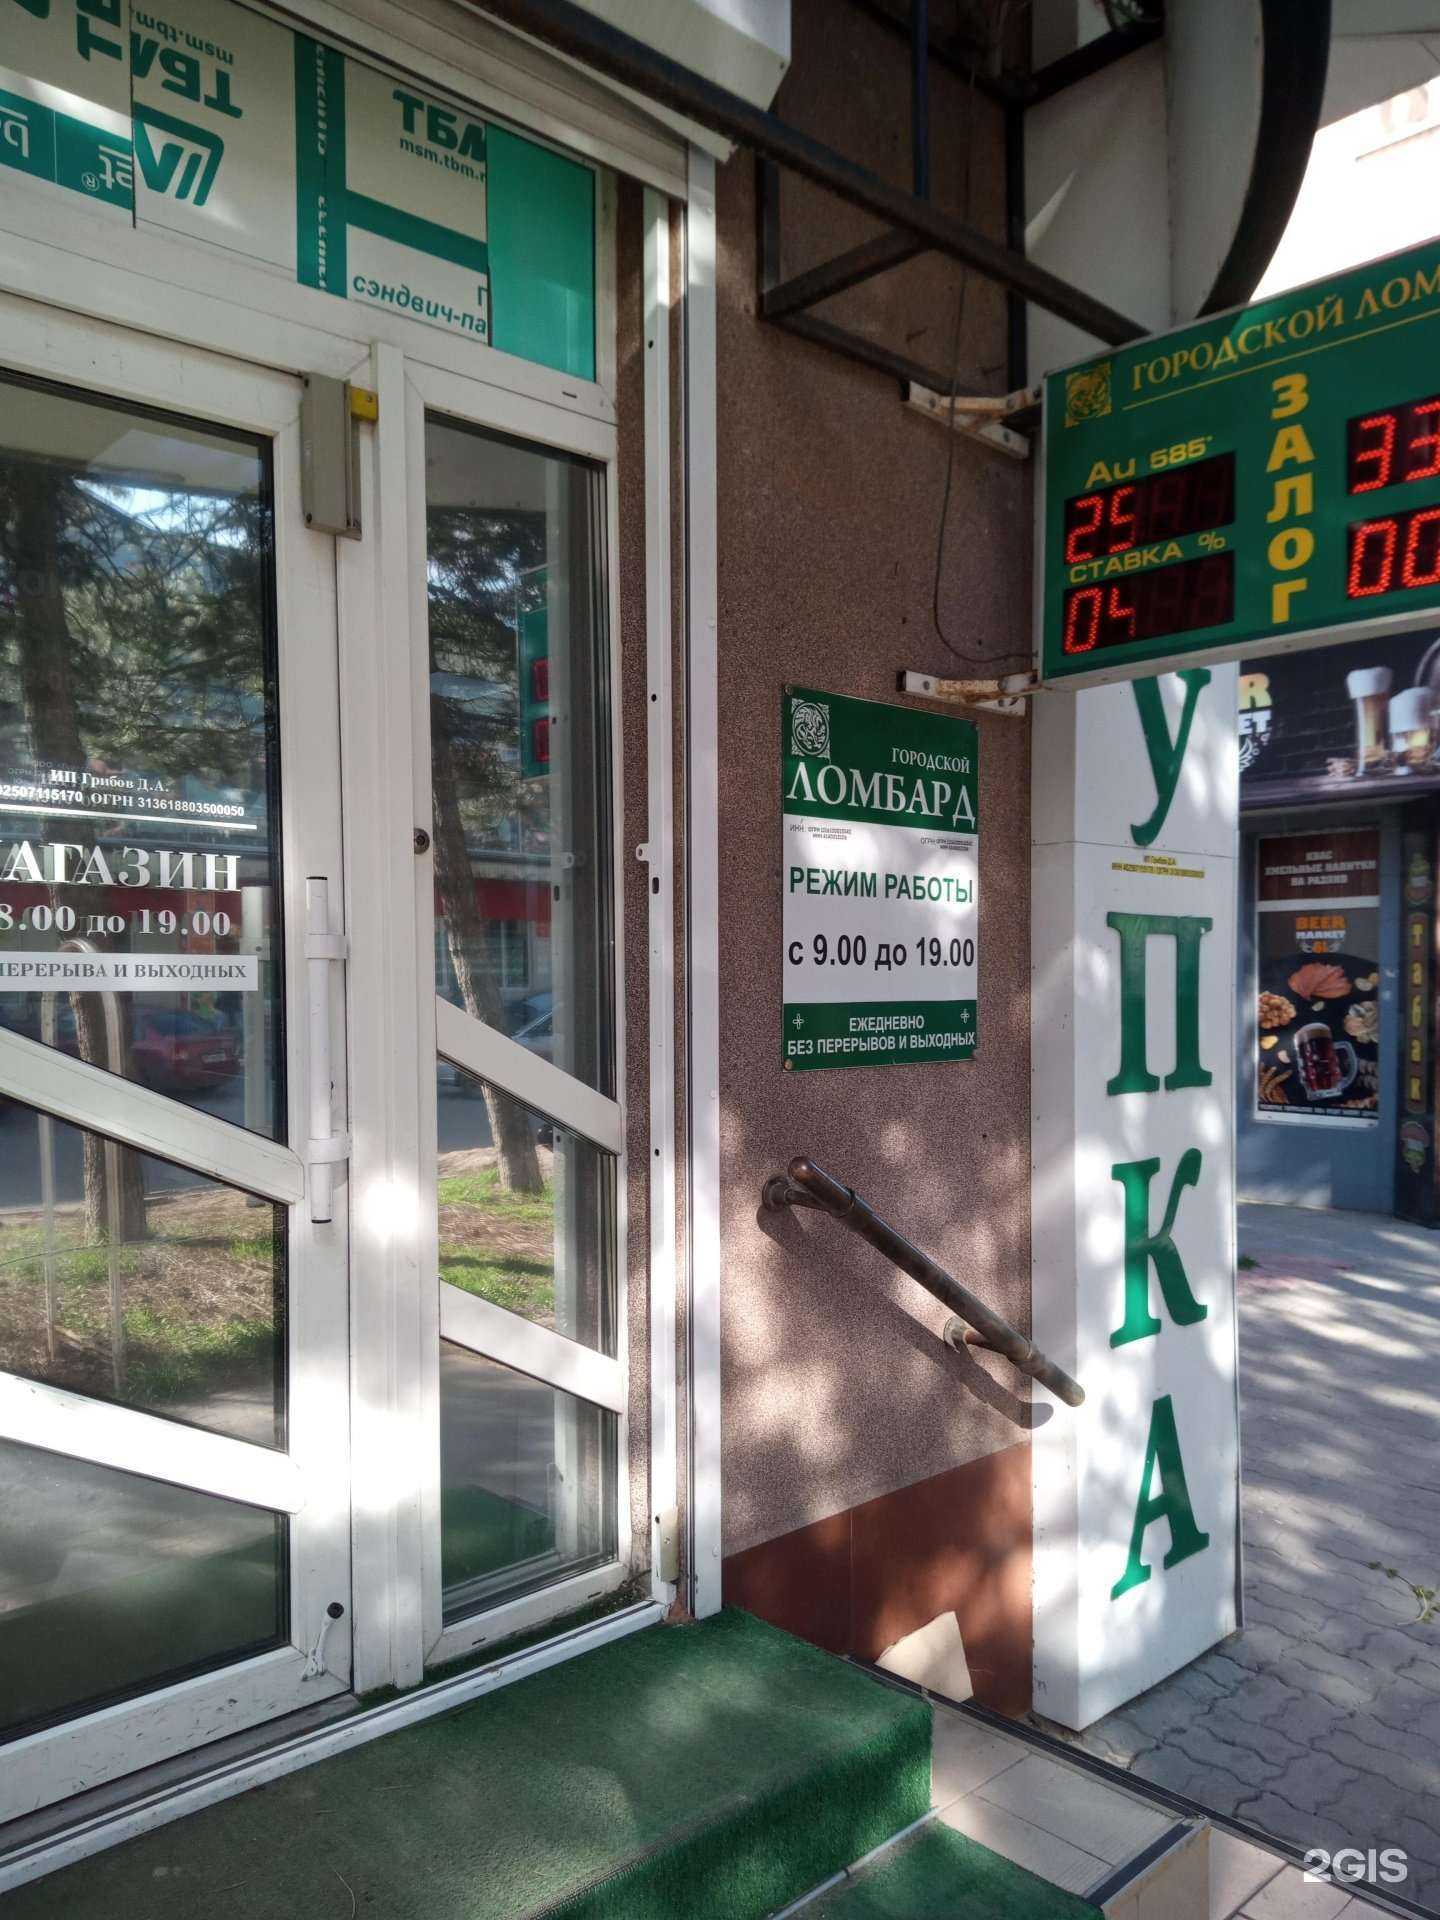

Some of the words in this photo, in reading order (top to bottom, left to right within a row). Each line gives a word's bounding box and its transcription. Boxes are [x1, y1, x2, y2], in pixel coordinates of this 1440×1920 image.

[1131, 294, 1344, 391] ГОРОДСКОЙ
[1085, 457, 1137, 489] Au
[1266, 372, 1315, 625] ЗАЛОГ
[1065, 486, 1136, 564] 25
[1069, 542, 1185, 584] СТАВКА
[1063, 586, 1136, 655] 04
[50, 769, 77, 784] ИП
[82, 772, 134, 789] Грибов
[892, 747, 970, 774] ГОРОДСКОЙ
[91, 792, 133, 807] ОГРН
[786, 761, 976, 829] ЛОМБАРД
[0, 840, 241, 891] АГАЗИН
[790, 866, 877, 898] РЕЖИМ
[885, 873, 973, 903] РАБОТЫ
[86, 914, 126, 937] до
[139, 909, 231, 936] 19.00
[813, 934, 867, 966] 9.00
[874, 943, 907, 971] до
[916, 937, 975, 967] 19.00
[113, 964, 128, 978] И
[134, 964, 247, 981] ВЫХОДНЫХ
[849, 1015, 925, 1033] ЕЖЕДНЕВНО
[787, 1039, 814, 1056] БЕЗ
[817, 1035, 896, 1054] ПЕРЕРЫВОВ
[899, 1034, 908, 1049] И
[910, 1032, 976, 1050] ВЫХОДНЫХ
